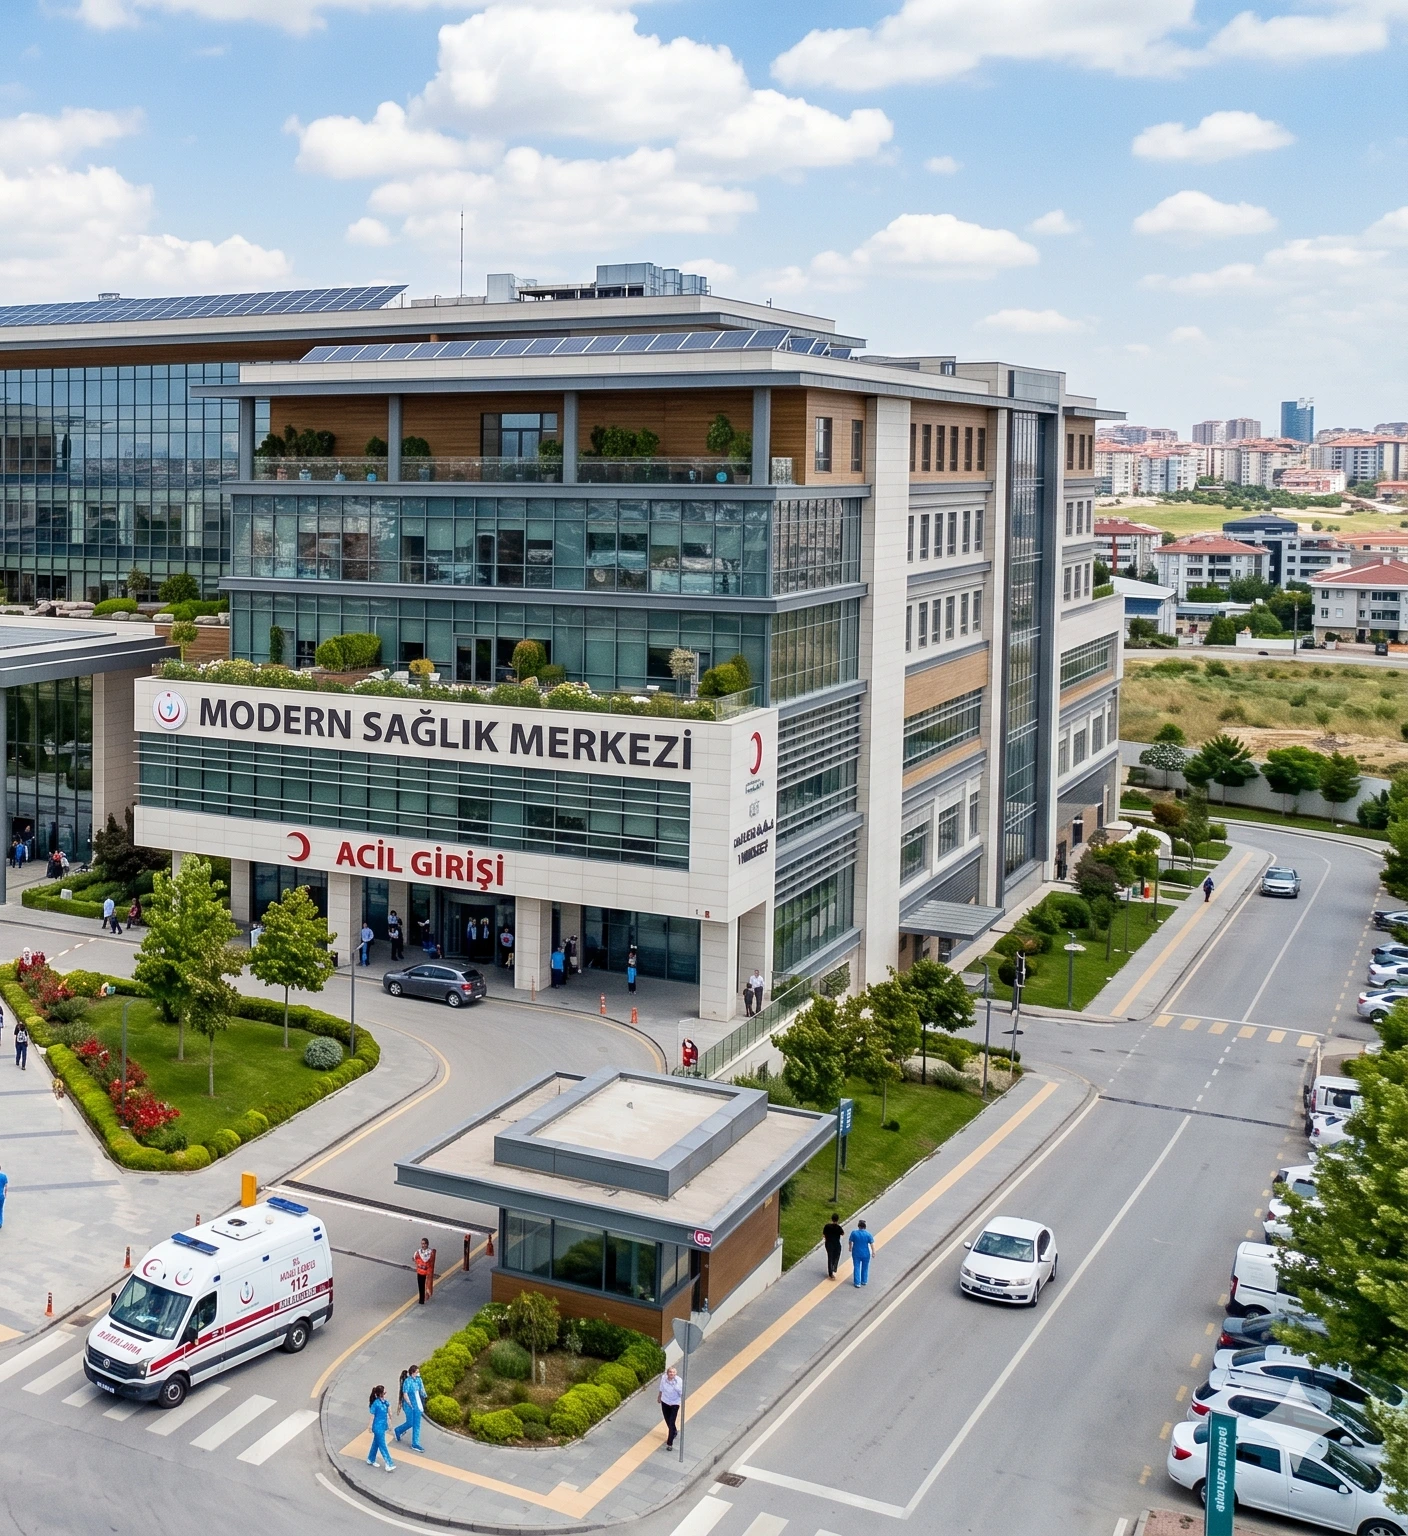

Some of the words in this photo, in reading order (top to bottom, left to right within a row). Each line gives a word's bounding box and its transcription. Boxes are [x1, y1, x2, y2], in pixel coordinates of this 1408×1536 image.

[200, 698, 351, 739] MODERN
[363, 708, 499, 752] SAĞLIK
[510, 723, 692, 770] MERKEZİ
[336, 839, 403, 873] ACİL
[411, 846, 504, 890] GİRİŞİ
[291, 1274, 309, 1292] 112
